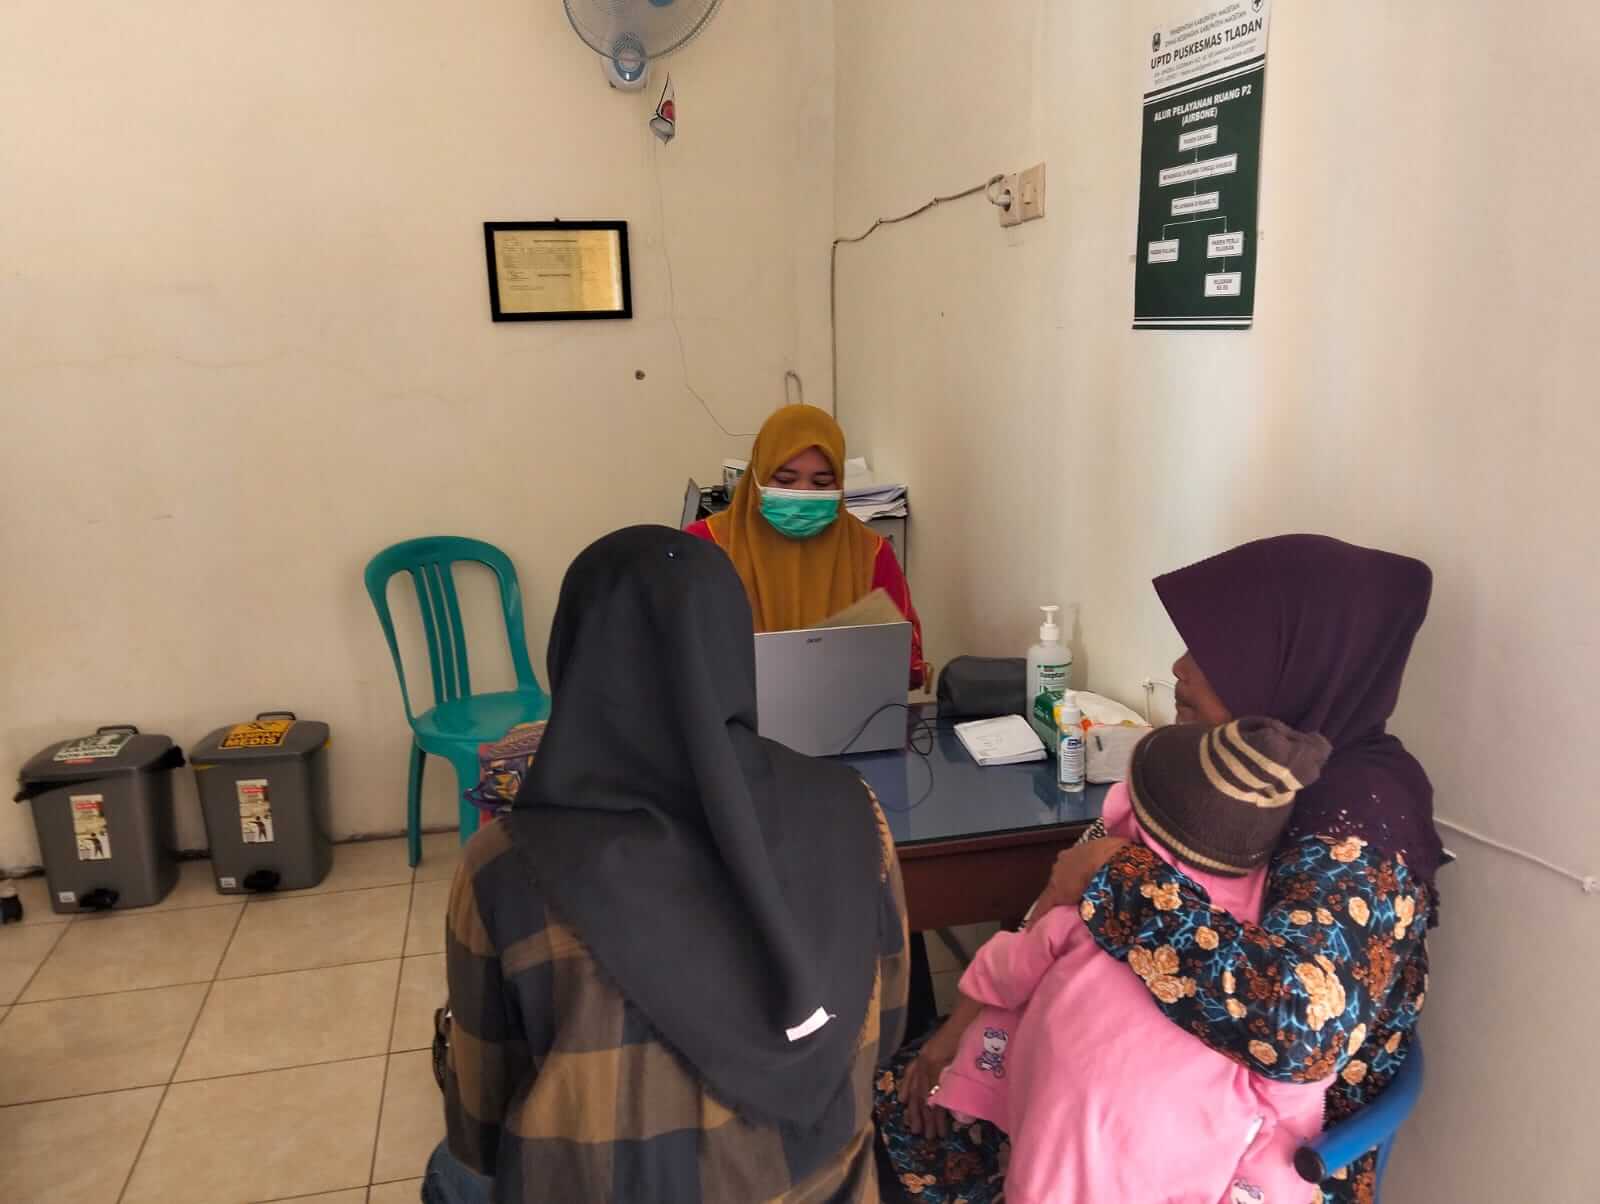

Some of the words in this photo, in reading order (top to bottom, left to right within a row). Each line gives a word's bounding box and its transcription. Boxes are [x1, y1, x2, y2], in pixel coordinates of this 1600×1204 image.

[1151, 52, 1171, 69] UPTD
[1173, 32, 1223, 62] PUSKESMAS
[1224, 17, 1263, 43] TLADAN
[1154, 109, 1172, 122] ALUR
[1172, 96, 1213, 116] PELAYANAN
[1214, 88, 1240, 104] RUANG
[1241, 84, 1252, 97] P2
